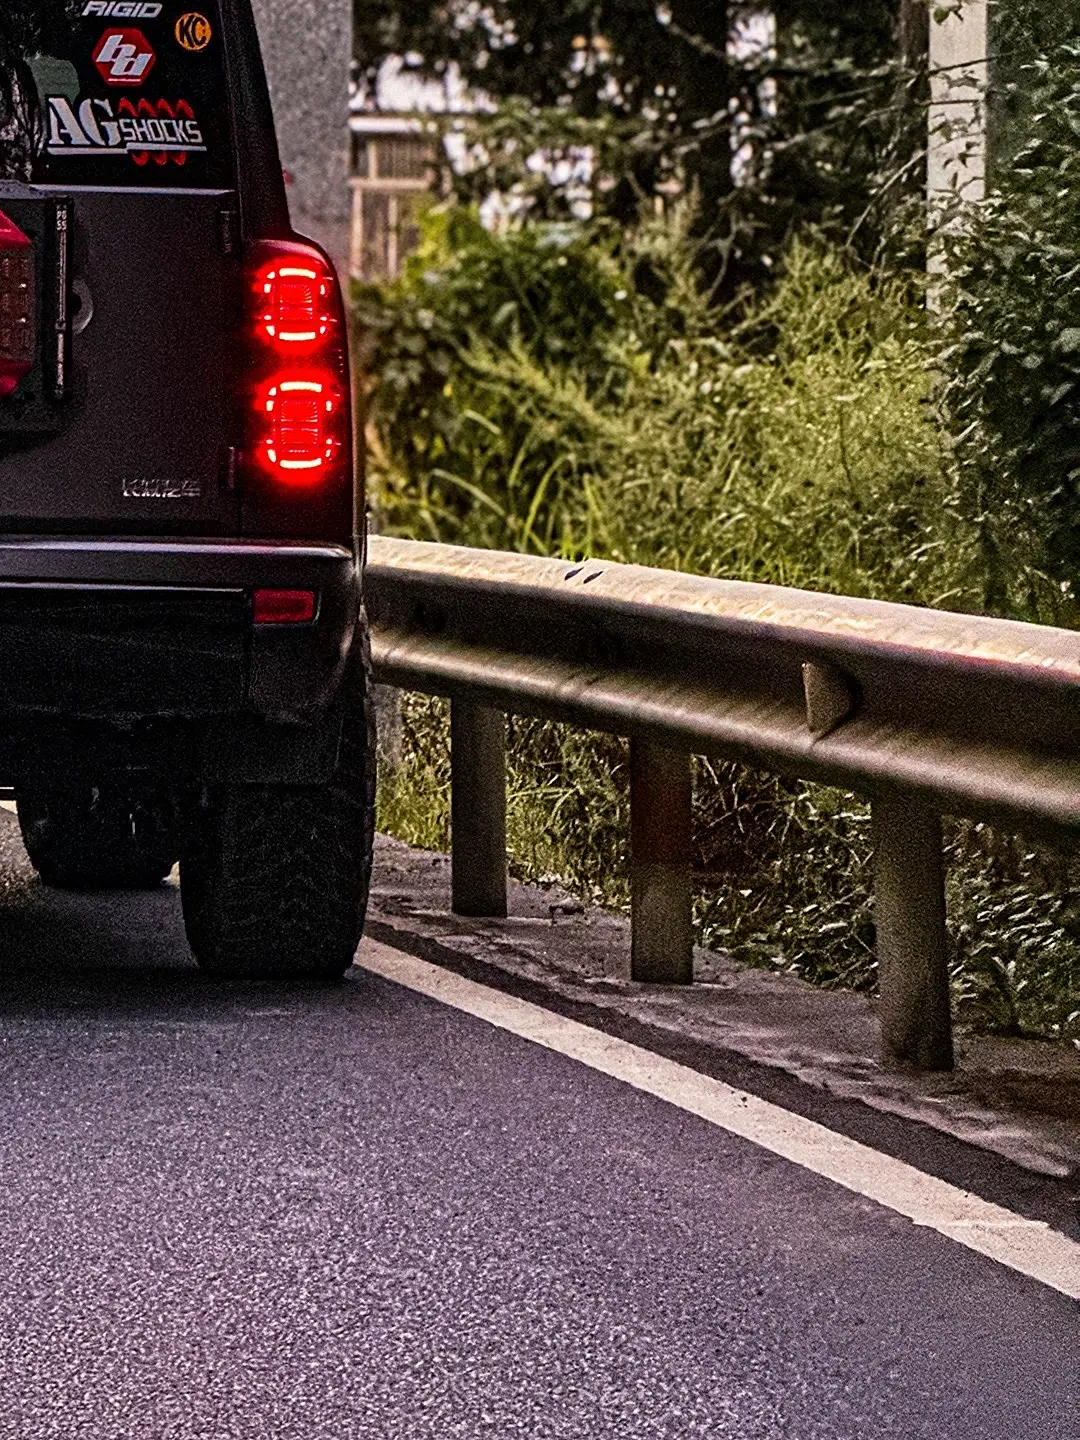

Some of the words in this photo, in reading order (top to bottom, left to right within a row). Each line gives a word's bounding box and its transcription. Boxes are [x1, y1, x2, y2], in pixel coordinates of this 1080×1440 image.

[82, 0, 163, 18] RIGID
[177, 13, 208, 49] KC
[48, 97, 121, 147] AG
[119, 118, 204, 144] SHOCKS
